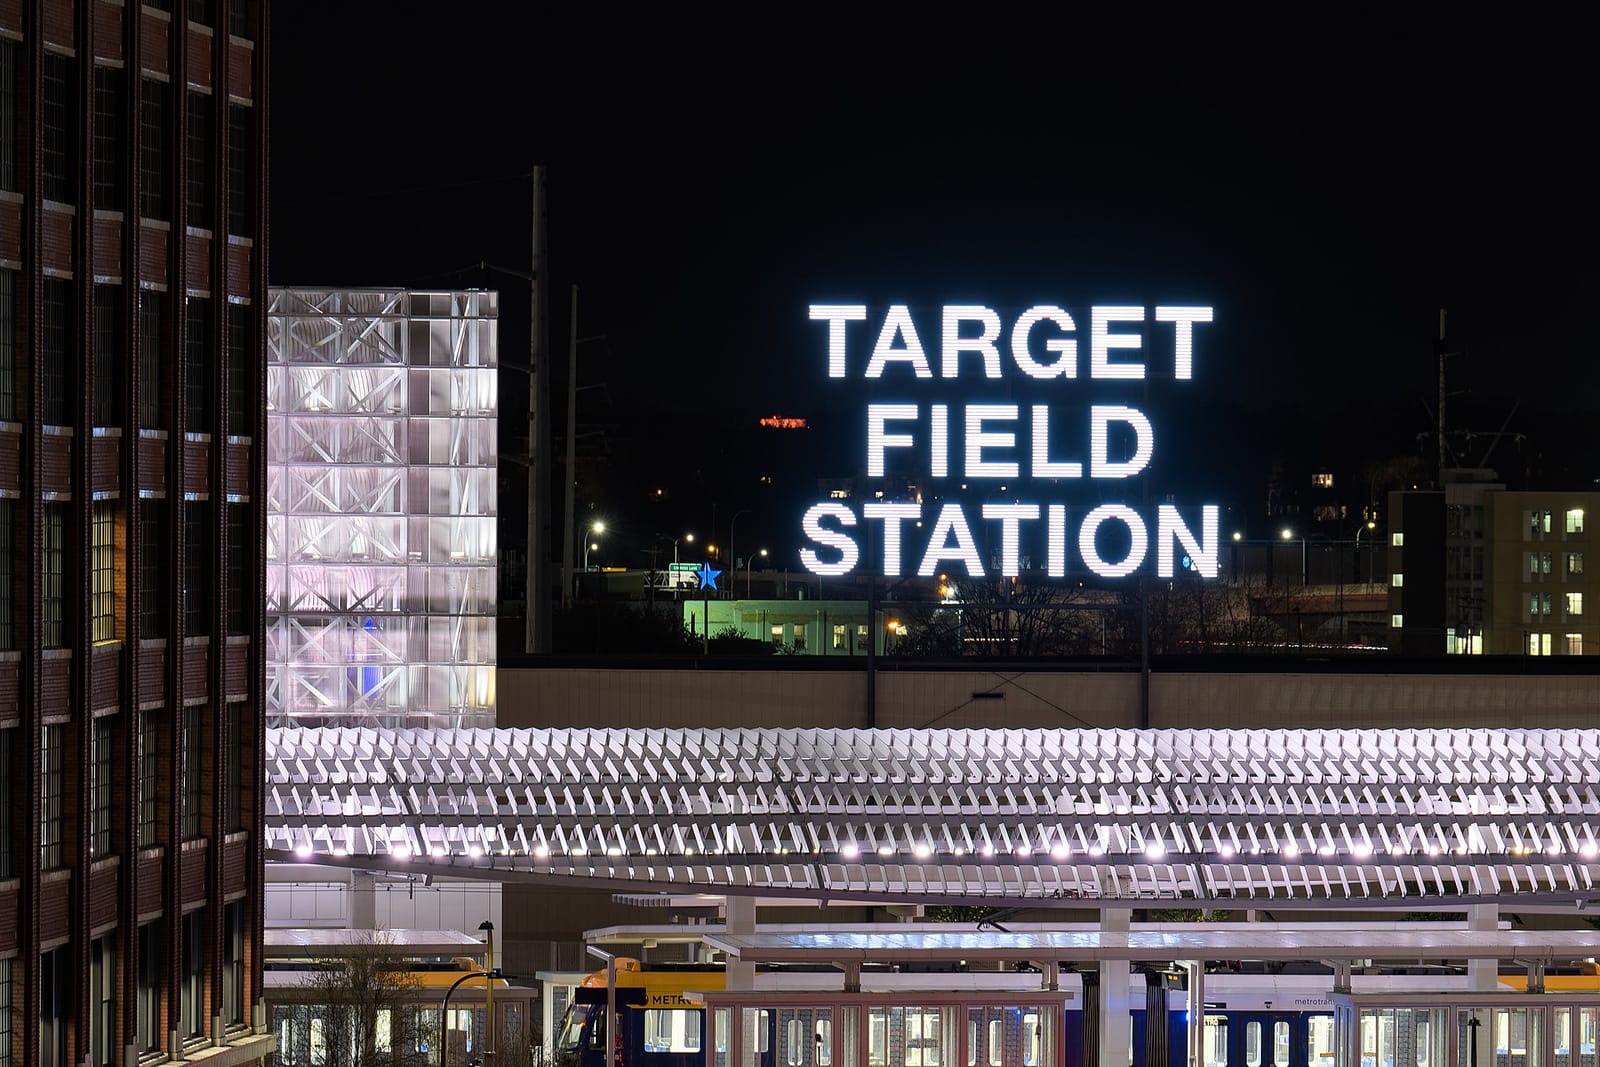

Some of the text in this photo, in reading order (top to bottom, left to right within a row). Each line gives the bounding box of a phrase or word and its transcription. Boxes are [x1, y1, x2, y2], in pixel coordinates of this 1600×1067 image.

[808, 304, 1214, 380] TARGET
[867, 404, 1154, 478] FIELD
[799, 502, 1220, 578] STATION
